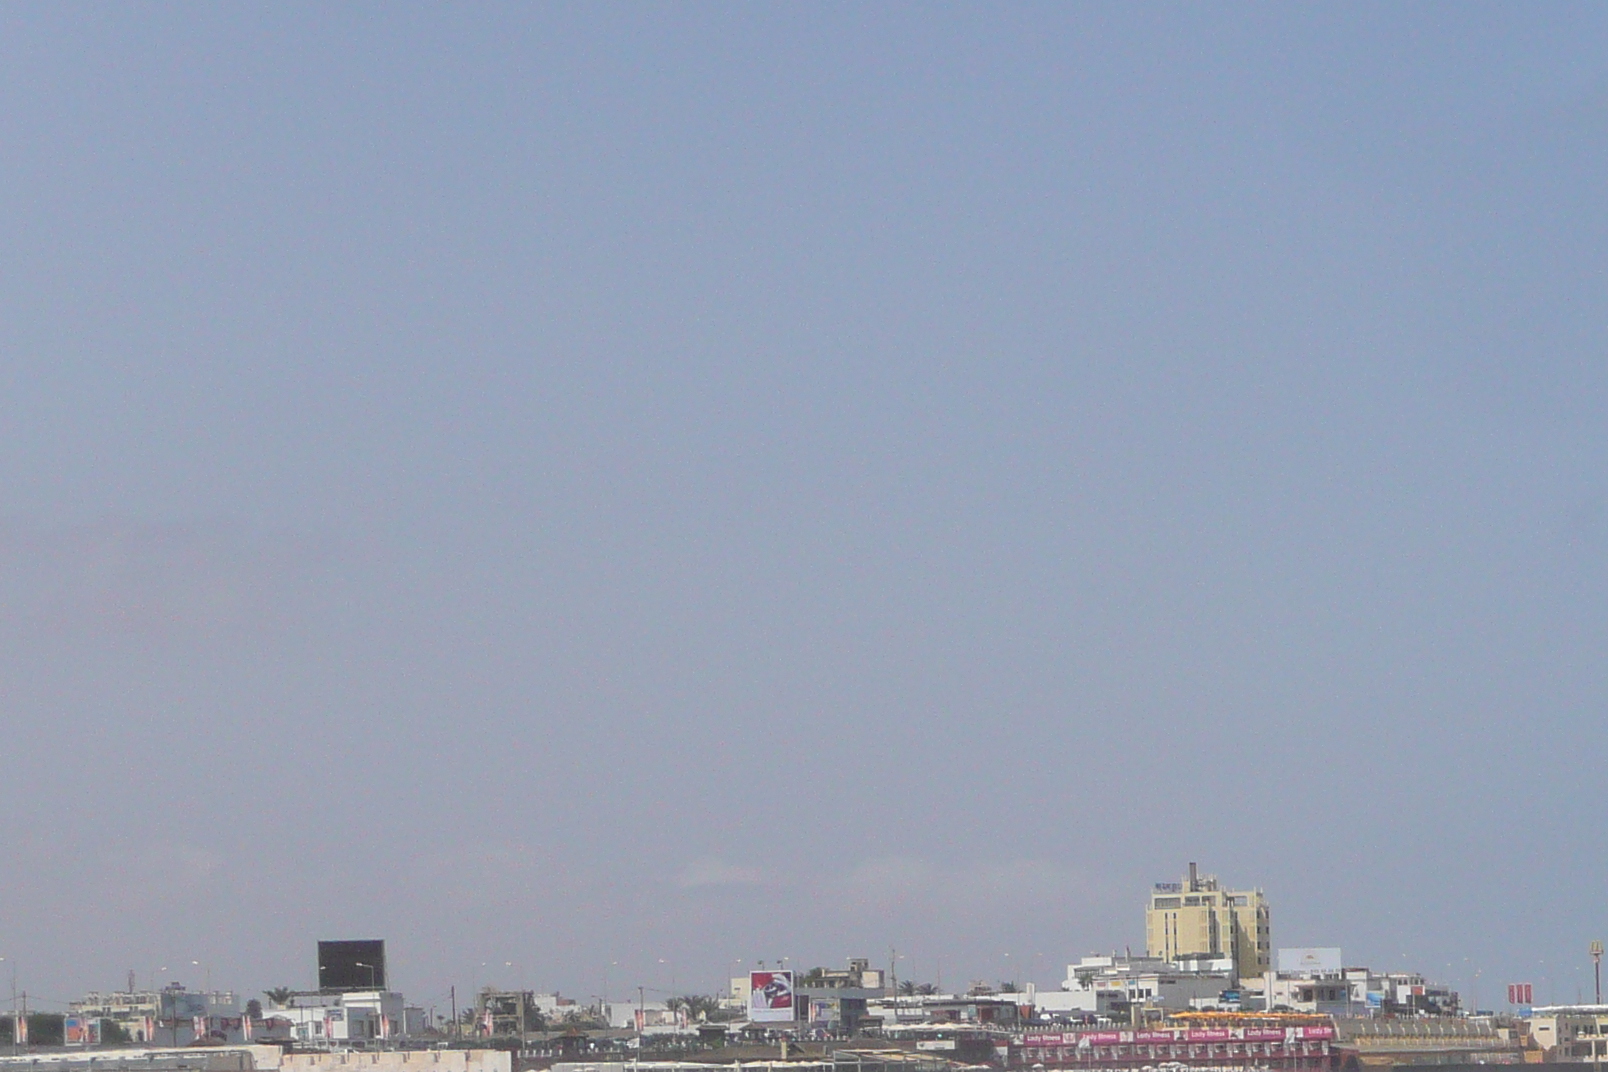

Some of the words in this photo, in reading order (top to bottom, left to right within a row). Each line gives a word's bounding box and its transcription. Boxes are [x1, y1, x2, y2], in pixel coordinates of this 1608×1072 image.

[1136, 1032, 1151, 1040] Lady
[1191, 1030, 1205, 1038] Lady
[1247, 1029, 1261, 1037] Lady
[1027, 1034, 1041, 1042] Lady
